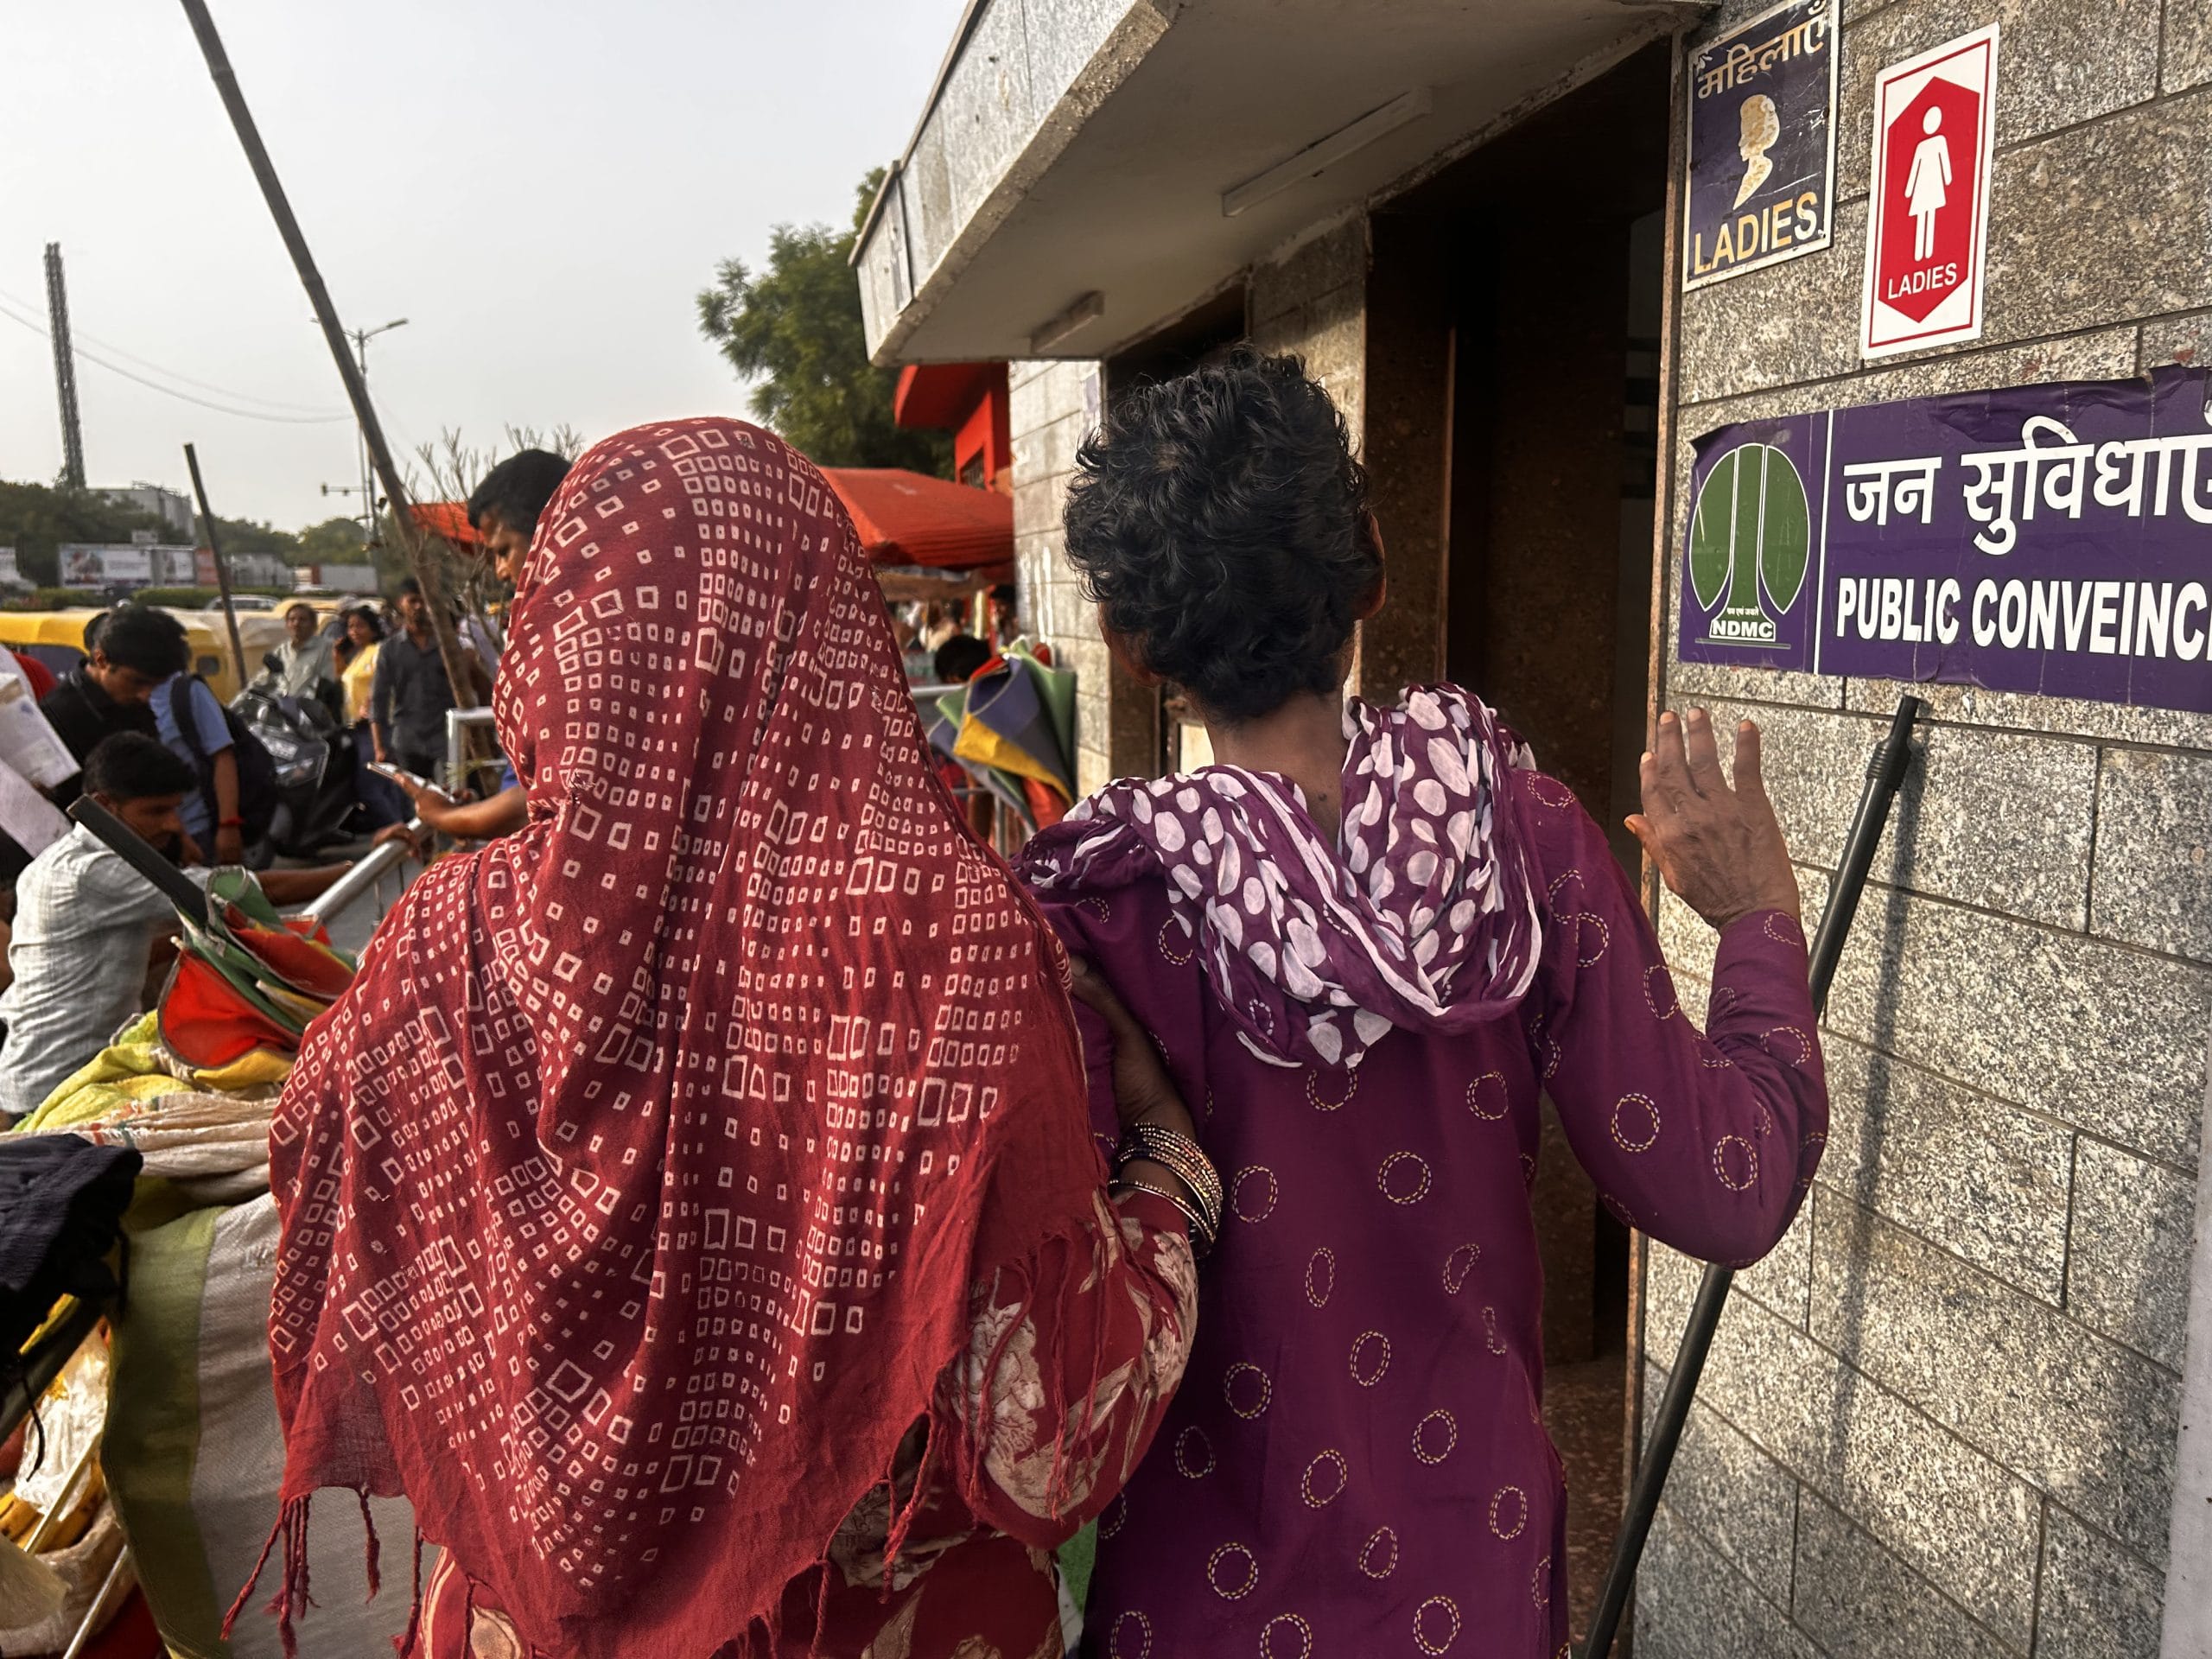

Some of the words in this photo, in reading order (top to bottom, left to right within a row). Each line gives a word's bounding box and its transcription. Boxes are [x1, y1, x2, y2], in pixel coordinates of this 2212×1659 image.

[1694, 192, 1818, 275] LADIES
[1887, 263, 1957, 300] LADIES
[1844, 457, 1942, 525] जन
[1712, 620, 1773, 638] NDMC
[1837, 578, 1961, 645] PUBLIC
[1972, 579, 2212, 661] CONVEINC
